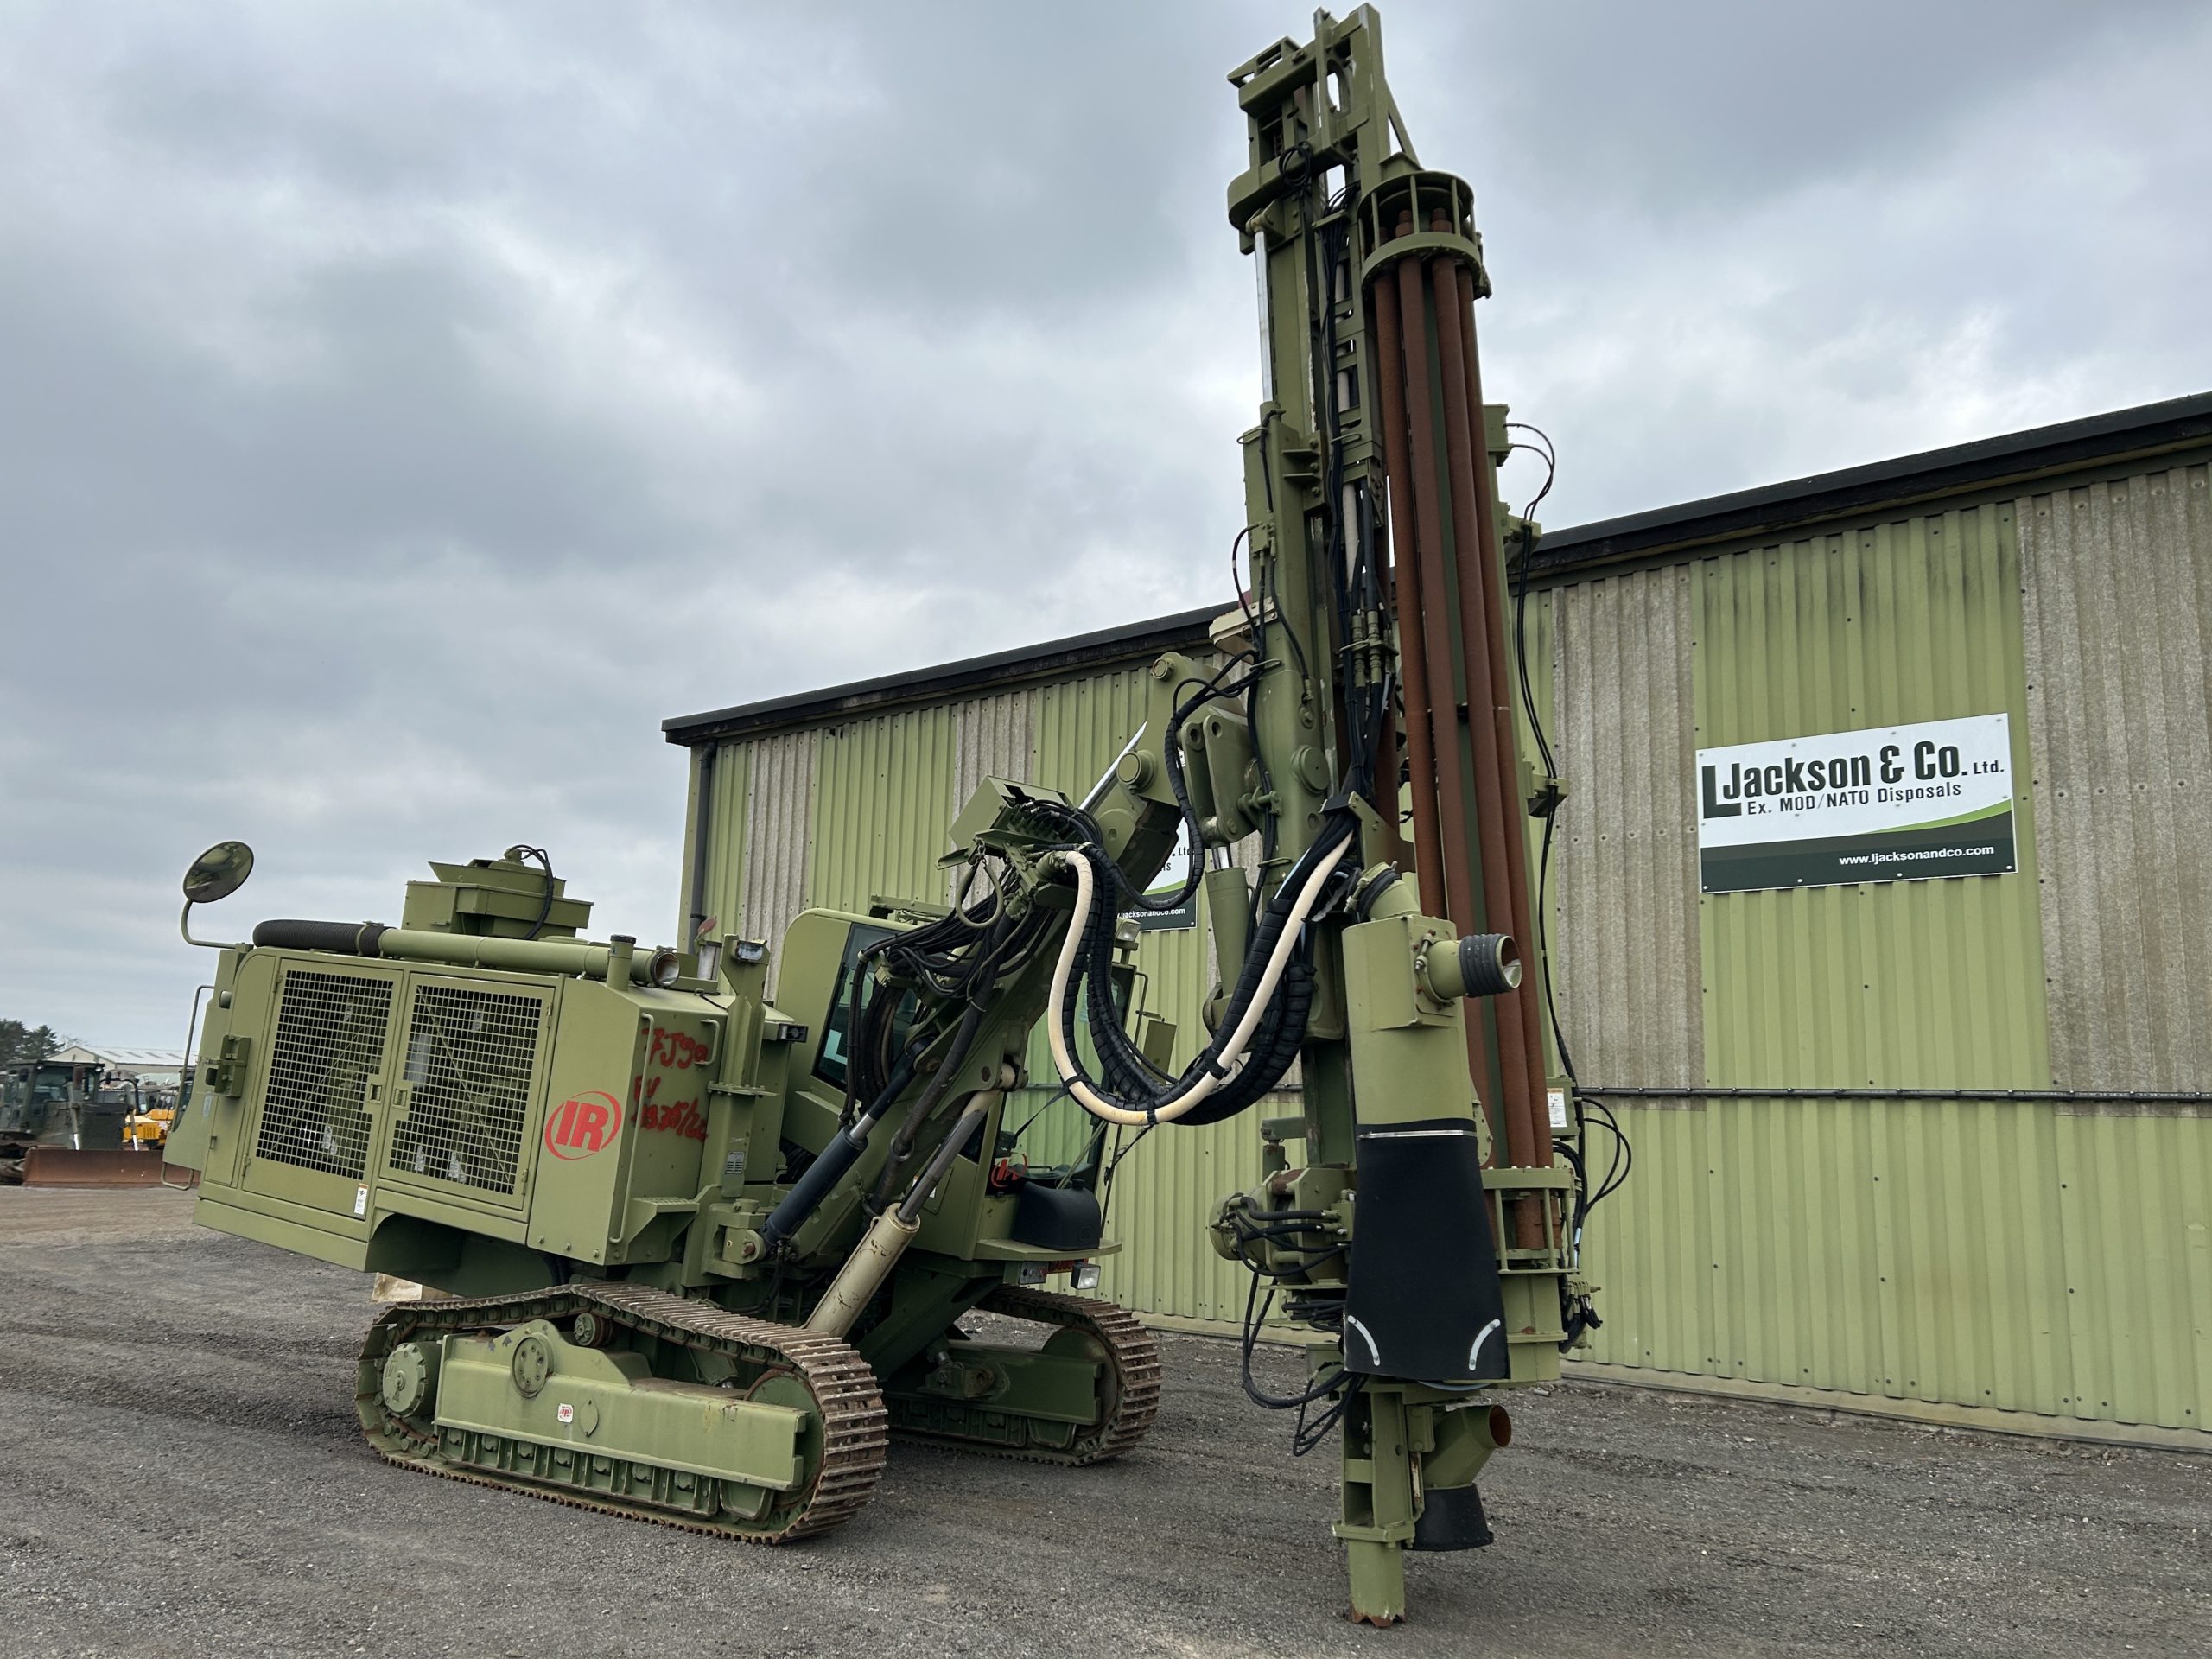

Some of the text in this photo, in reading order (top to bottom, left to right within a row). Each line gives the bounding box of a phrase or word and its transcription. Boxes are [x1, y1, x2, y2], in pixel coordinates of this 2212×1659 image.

[1879, 744, 1904, 784] &
[1914, 741, 1968, 781] Co.
[1973, 760, 2005, 776] Ltd.
[1747, 781, 1962, 816] Ex. MOD/NATO Disposals
[1839, 846, 1994, 866] www.ljacksonandco.com
[555, 1099, 609, 1153] IR
